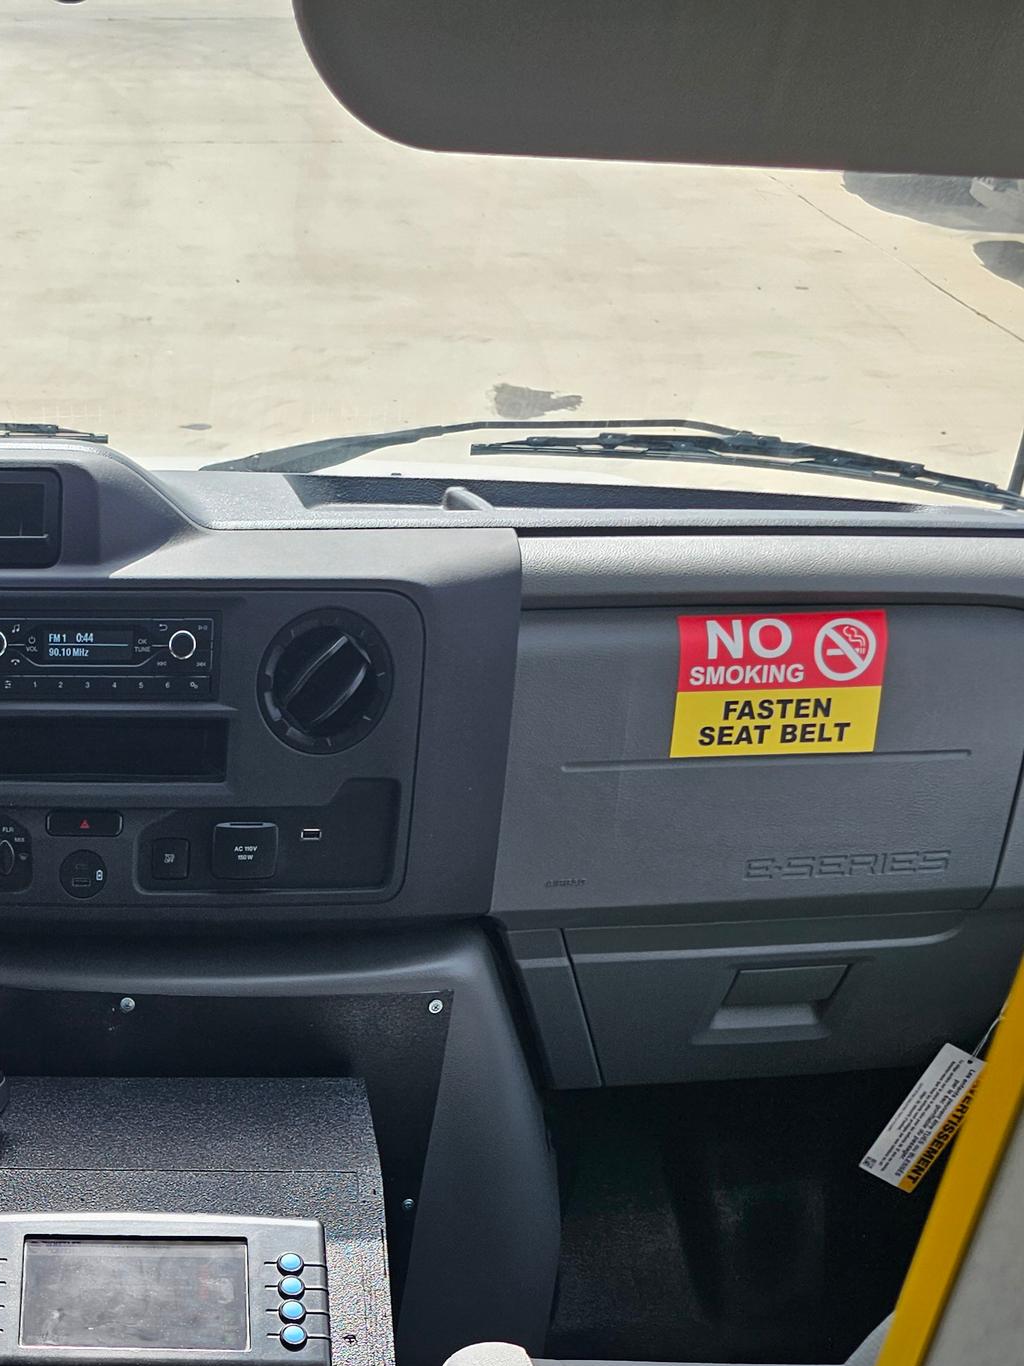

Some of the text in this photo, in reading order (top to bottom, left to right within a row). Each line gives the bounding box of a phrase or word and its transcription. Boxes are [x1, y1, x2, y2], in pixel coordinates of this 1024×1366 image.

[48, 633, 93, 643] FM 1 0:44
[706, 618, 792, 660] NO
[48, 648, 89, 657] 90.10 MHz
[689, 664, 805, 685] SMOKING
[723, 698, 832, 720] FASTEN
[698, 722, 851, 746] SEAT BELT
[744, 850, 952, 879] E-SERIES
